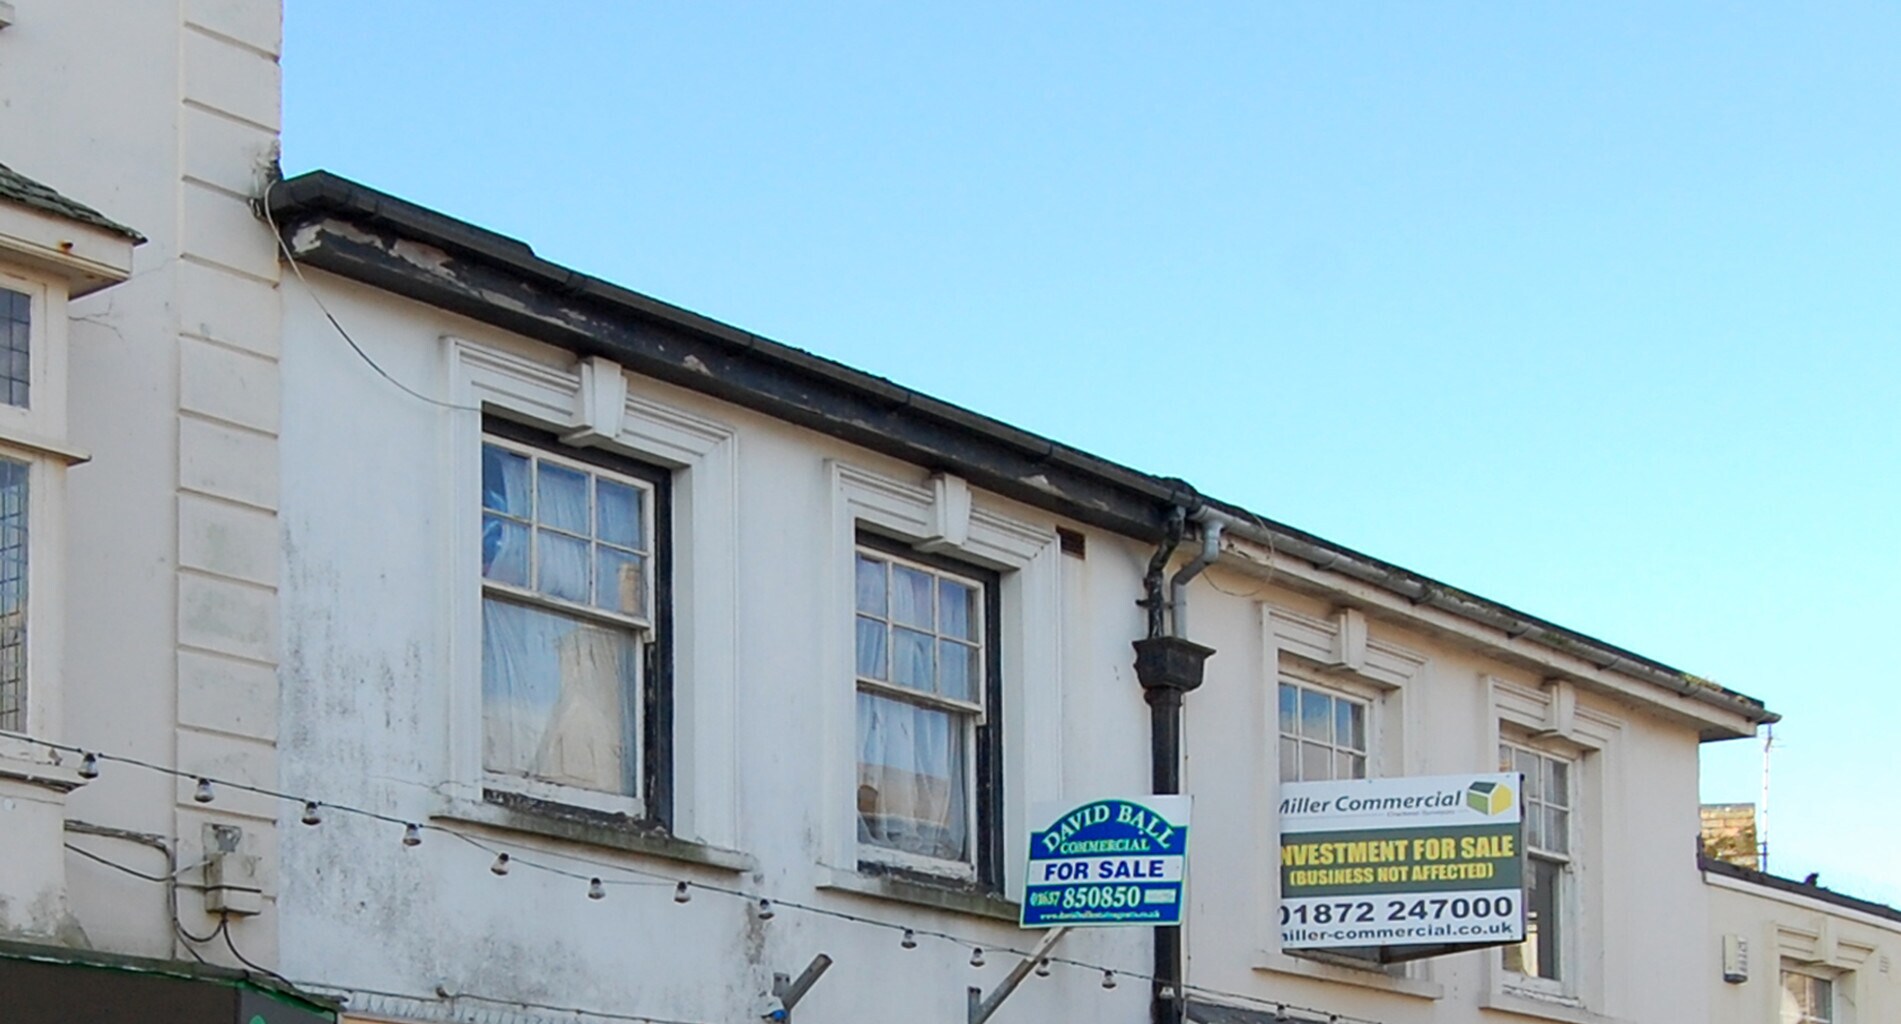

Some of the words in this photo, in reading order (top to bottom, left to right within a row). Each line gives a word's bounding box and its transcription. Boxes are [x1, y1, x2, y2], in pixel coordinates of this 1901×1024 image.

[1335, 791, 1462, 812] Commercial
[1043, 804, 1110, 852] DAVID
[1117, 804, 1175, 849] BALL
[1060, 839, 1150, 854] COMMERCIAL
[1281, 840, 1408, 866] NVESTMENT
[1413, 838, 1456, 861] FOR
[1461, 835, 1514, 858] SALE
[1044, 862, 1089, 881] FOR
[1098, 860, 1164, 879] SALE
[1289, 867, 1373, 886] (BUSINESS
[1377, 865, 1409, 882] NOT
[1412, 862, 1494, 881] AFFECTED)
[1062, 885, 1141, 909] 850850
[1388, 896, 1513, 922] 247000
